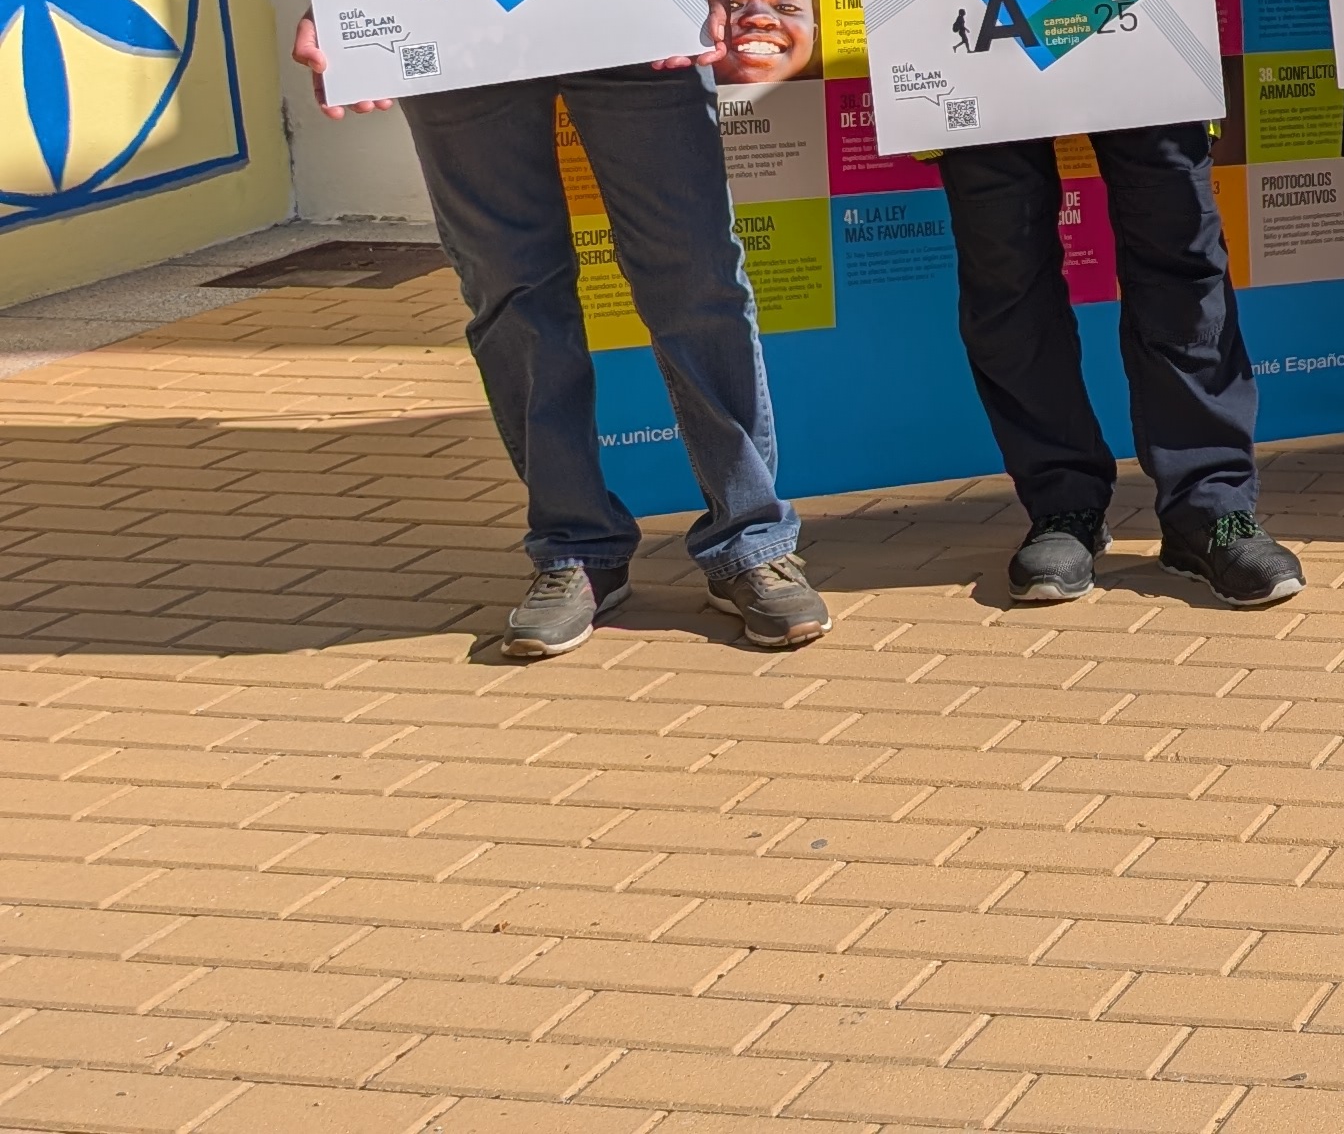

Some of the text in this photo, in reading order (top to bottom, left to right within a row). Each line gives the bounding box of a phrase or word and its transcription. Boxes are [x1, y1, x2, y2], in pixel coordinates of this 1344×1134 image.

[339, 9, 365, 21] GUÍA
[340, 16, 395, 31] DEL PLAN
[1094, 1, 1138, 35] 25
[342, 25, 403, 41] EDUCATIVO
[1278, 64, 1335, 81] CONFLICTO
[1259, 82, 1316, 100] ARMADOS
[1262, 171, 1332, 192] PROTOCOLOS
[1262, 189, 1337, 209] FACULTATIVOS
[843, 205, 906, 225] 41. LA LEY
[844, 220, 946, 243] MÁS FAVORABLE
